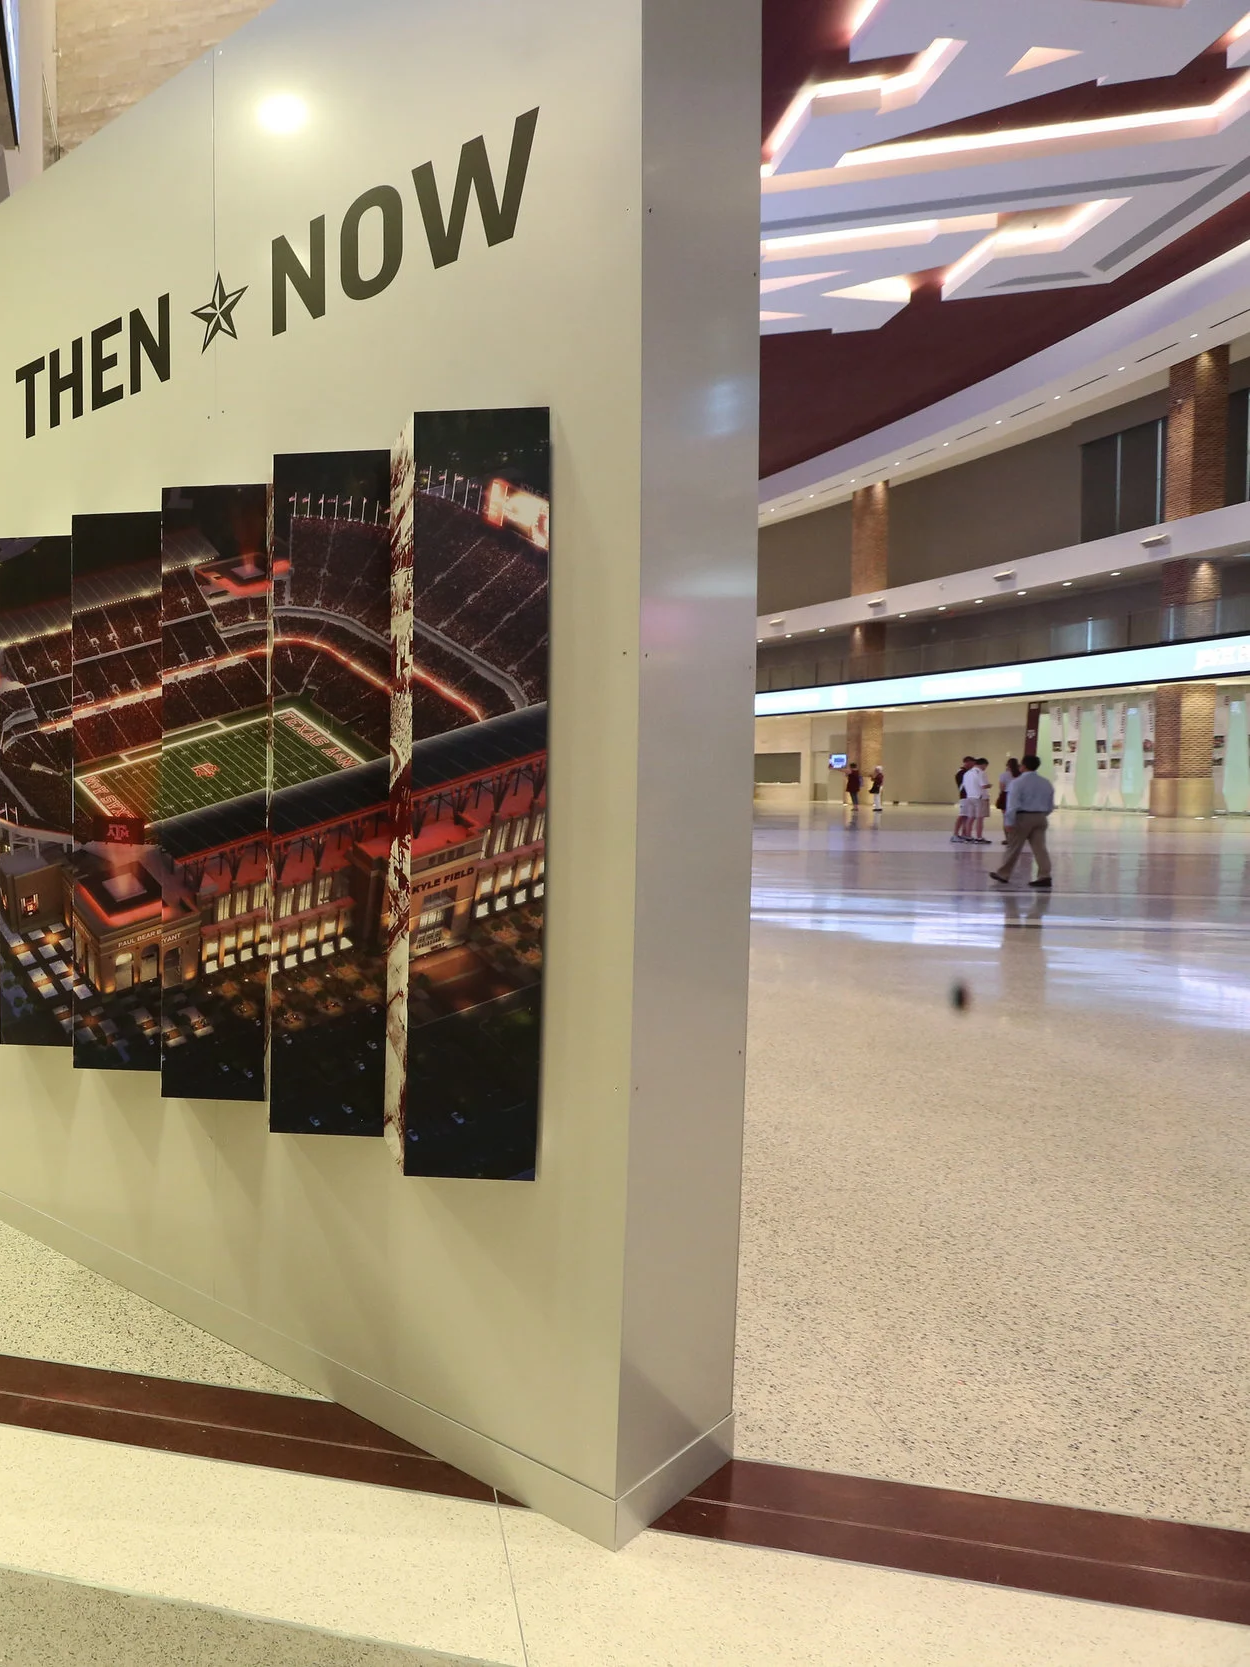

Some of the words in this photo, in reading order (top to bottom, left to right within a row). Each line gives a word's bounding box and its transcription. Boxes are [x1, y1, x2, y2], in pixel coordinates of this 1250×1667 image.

[15, 292, 171, 440] THEN
[271, 106, 540, 337] NOW
[278, 711, 330, 747] TEXAS
[412, 878, 441, 894] KYLE
[443, 867, 475, 885] FIELD
[117, 937, 136, 948] PAUL
